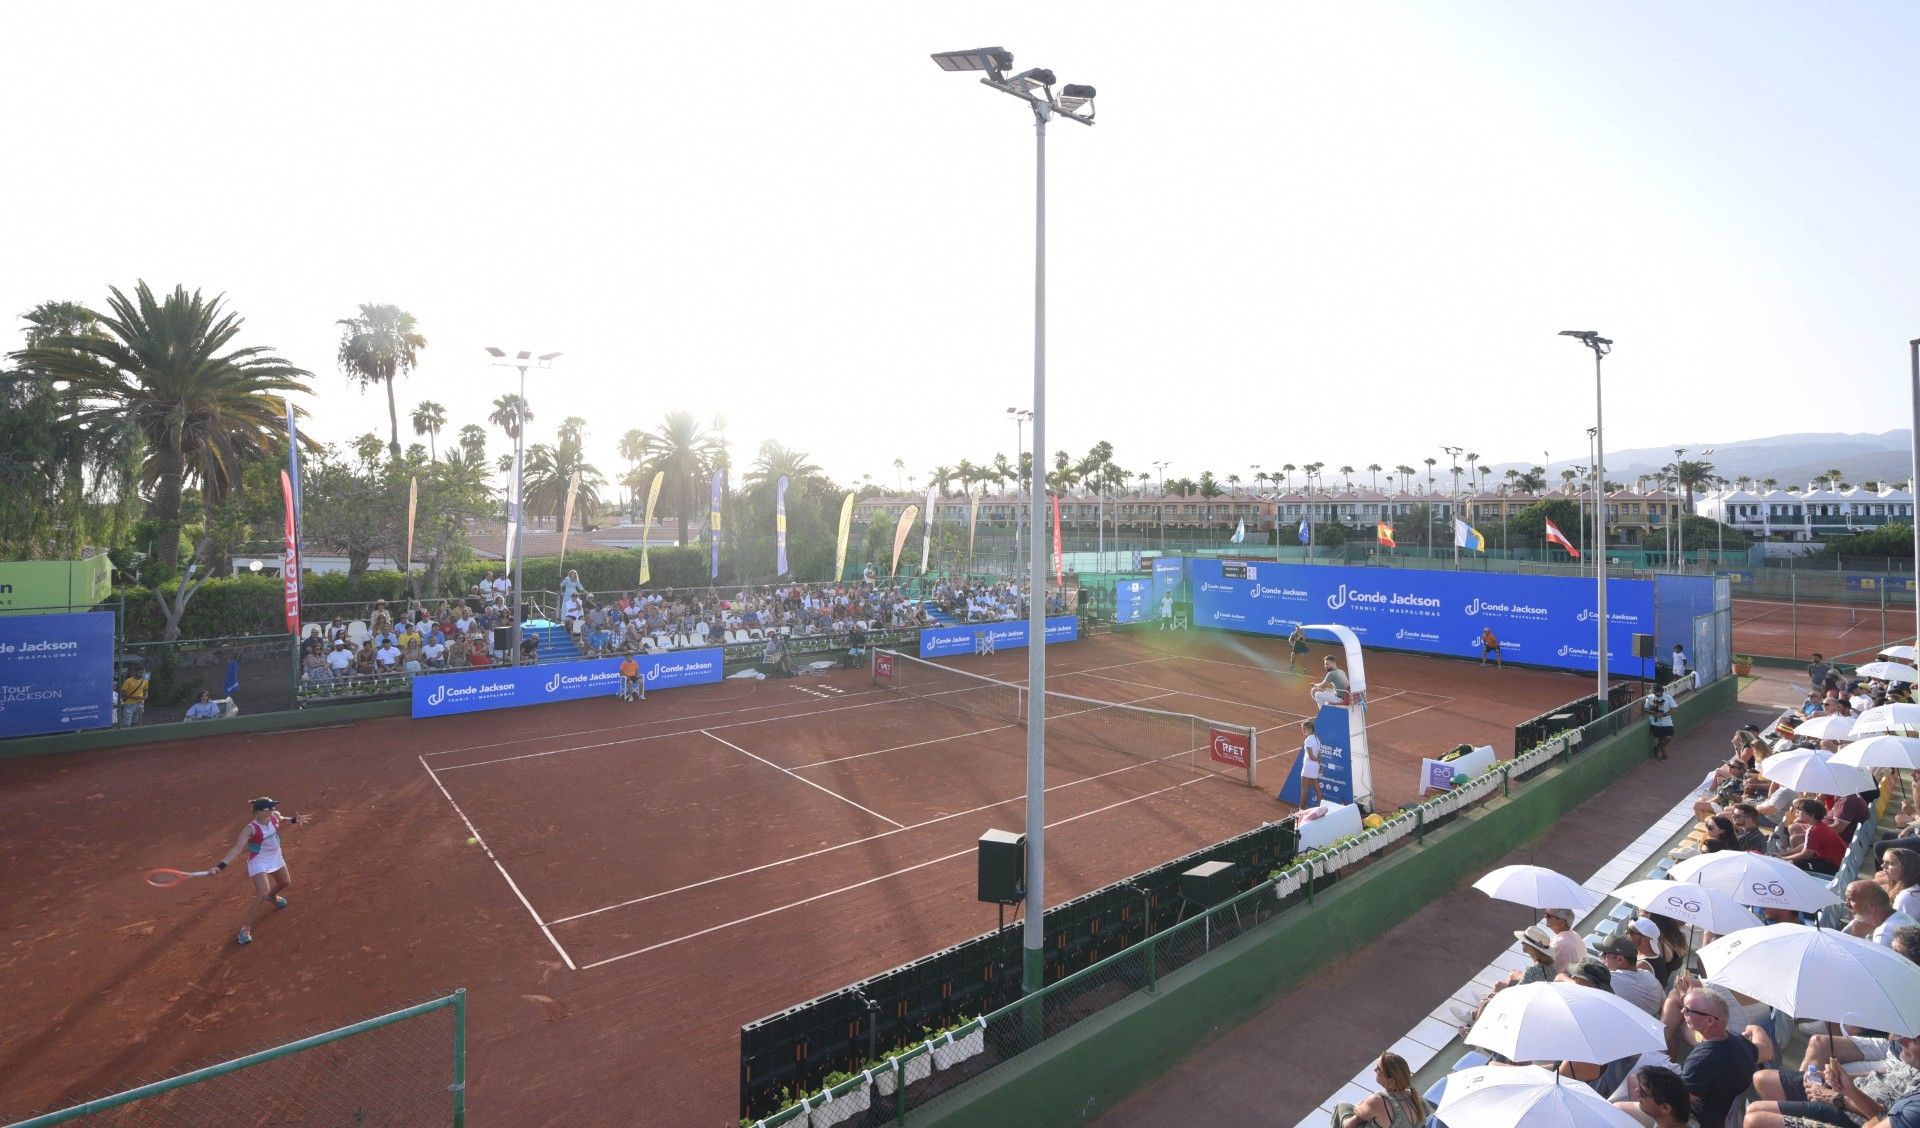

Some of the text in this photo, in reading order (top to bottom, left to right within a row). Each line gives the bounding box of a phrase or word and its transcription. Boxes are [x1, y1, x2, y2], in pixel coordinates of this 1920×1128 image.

[1282, 588, 1307, 596] Jackson
[1348, 590, 1440, 608] Conde Jackson
[1389, 608, 1441, 617] MASPALOMAS
[1481, 602, 1548, 614] Conde Jackson
[19, 641, 78, 652] Jackson
[1569, 647, 1588, 655] Conde
[661, 662, 712, 673] Conde Jackson
[561, 672, 620, 684] Conde Jackson
[2, 685, 31, 694] Tour
[446, 683, 515, 696] Conde Jackson
[0, 690, 62, 702] JACKSON
[1222, 742, 1245, 757] RFET
